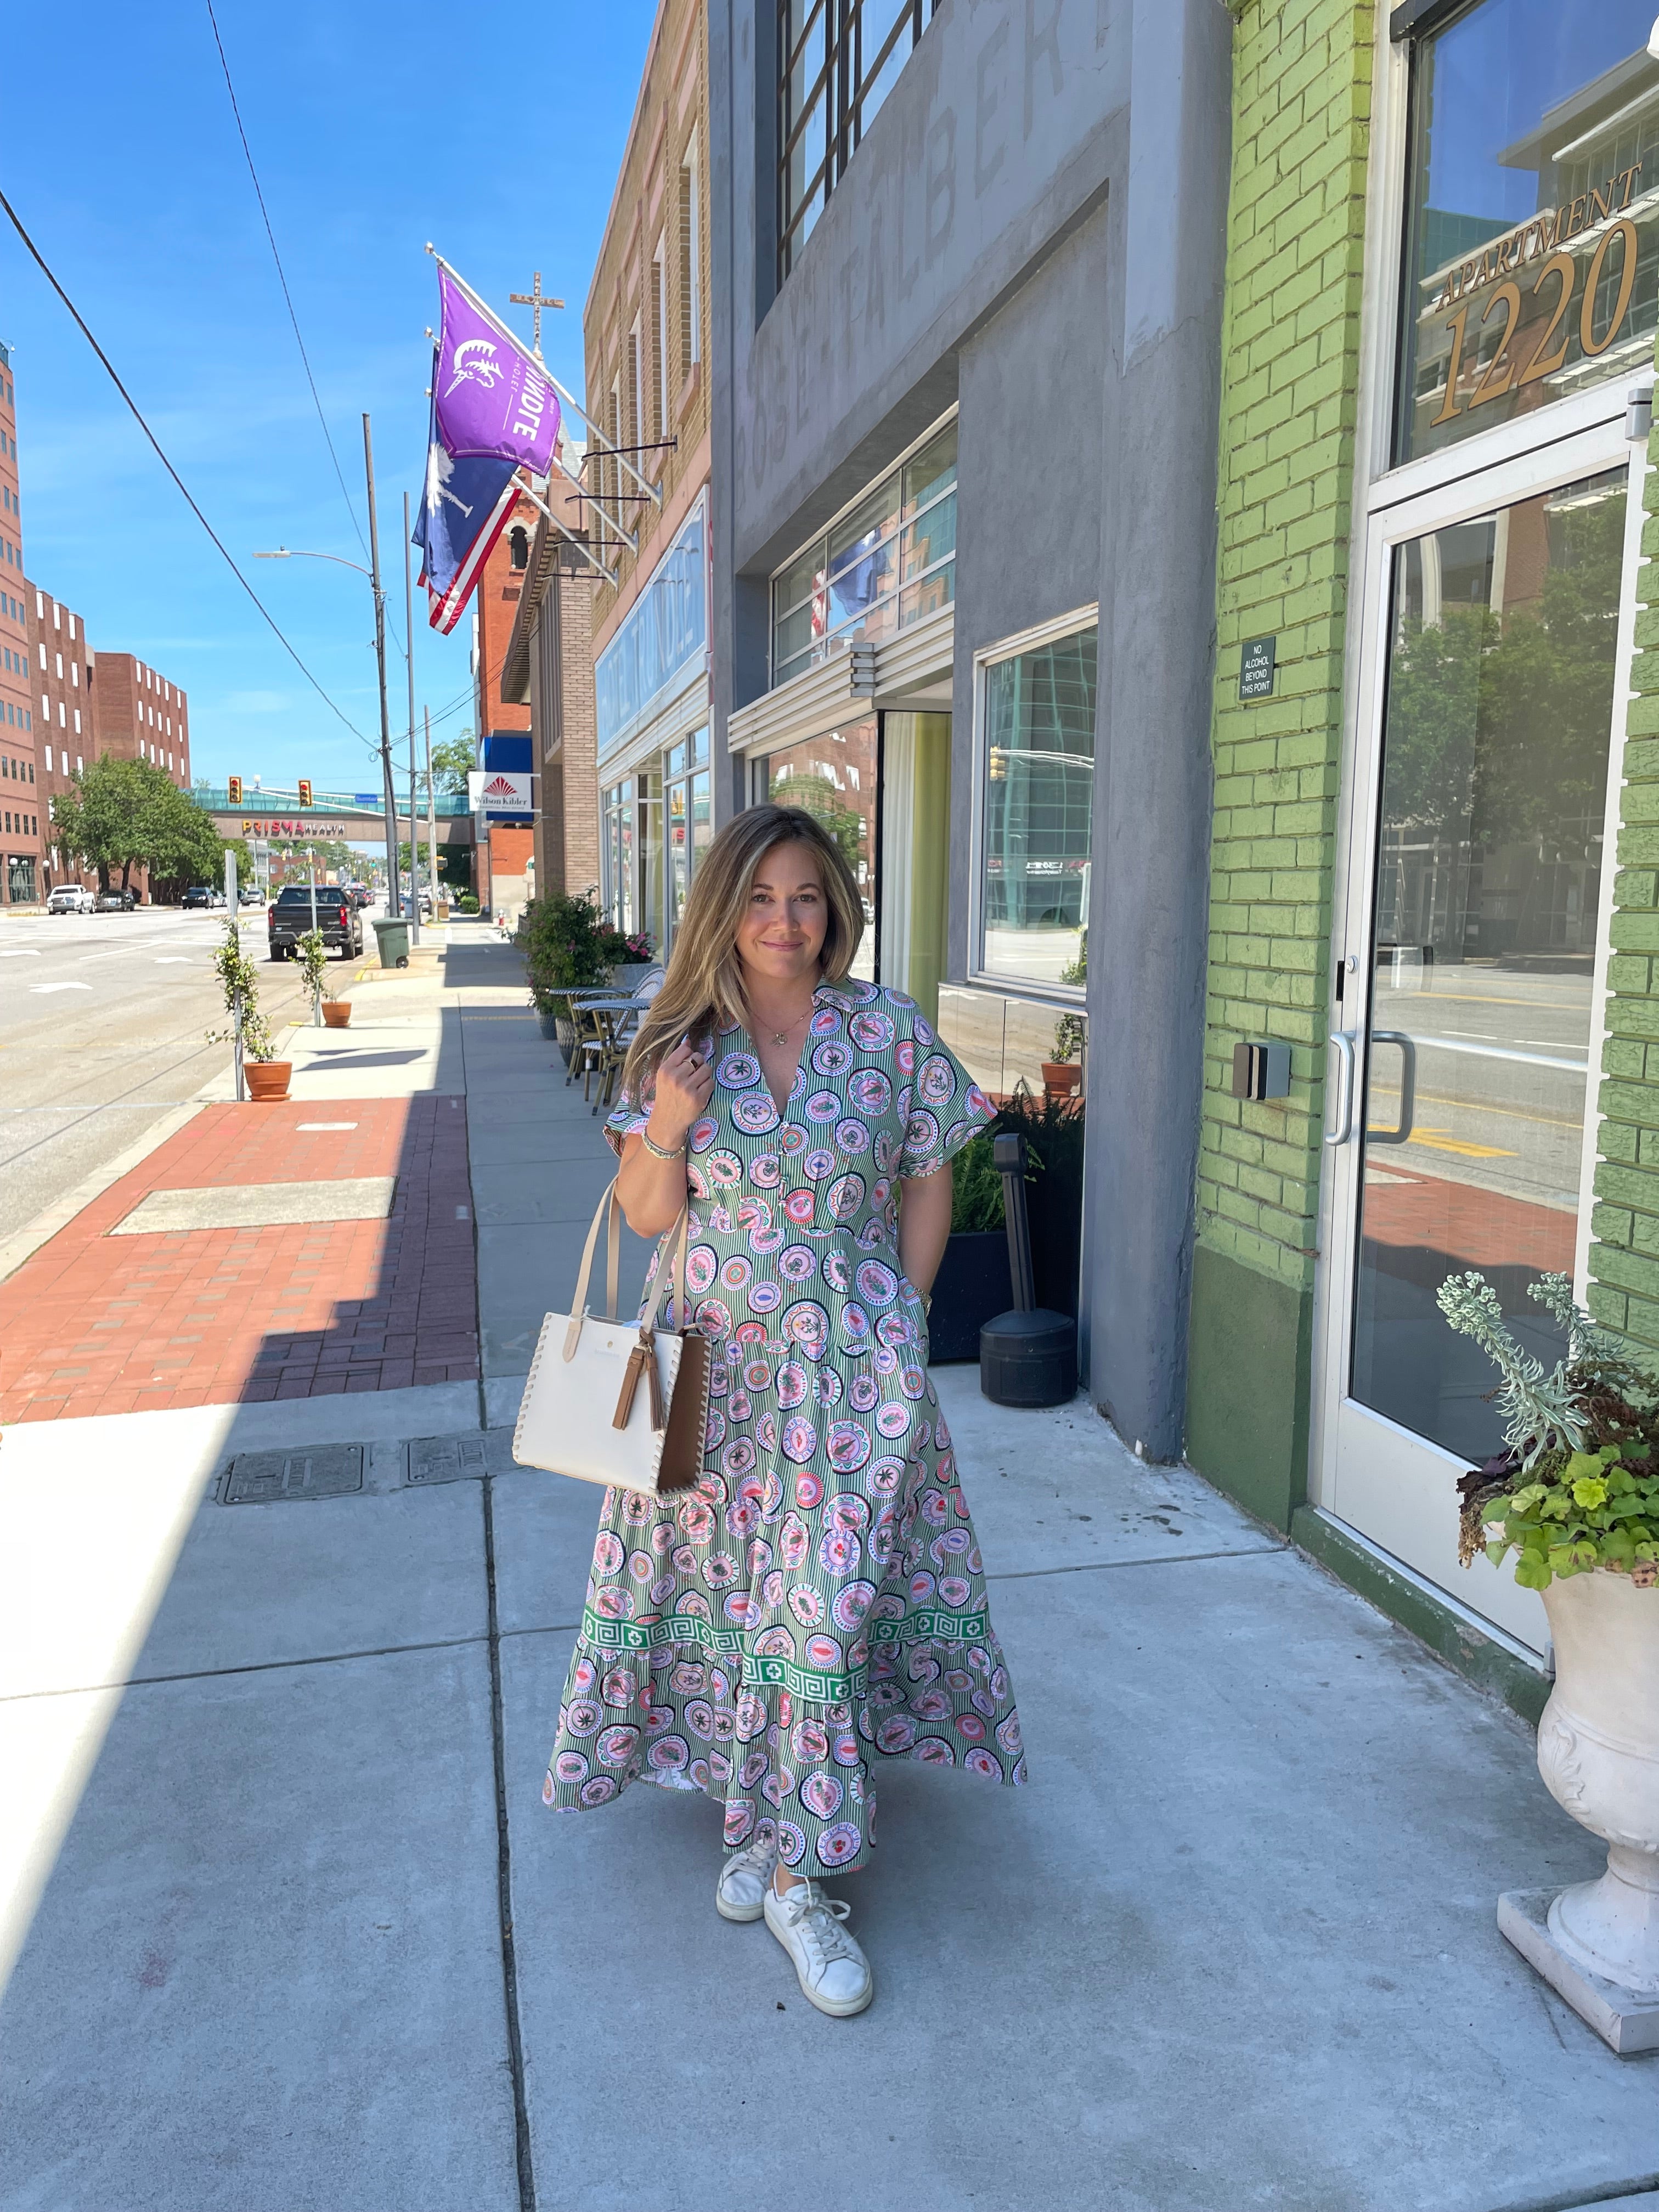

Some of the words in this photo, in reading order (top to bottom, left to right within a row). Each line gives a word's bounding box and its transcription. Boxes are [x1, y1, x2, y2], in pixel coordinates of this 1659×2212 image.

[1435, 161, 1643, 312] APARTMENT
[1430, 218, 1638, 428] 1220
[1254, 645, 1262, 654] NO
[1245, 656, 1269, 669] ALCOHOL
[1245, 669, 1267, 681] BEYOND
[1242, 684, 1253, 695] THIS
[1254, 681, 1270, 692] POINT
[474, 796, 501, 804] Wilson
[242, 820, 304, 833] PRISMA
[306, 823, 345, 832] HEALTH
